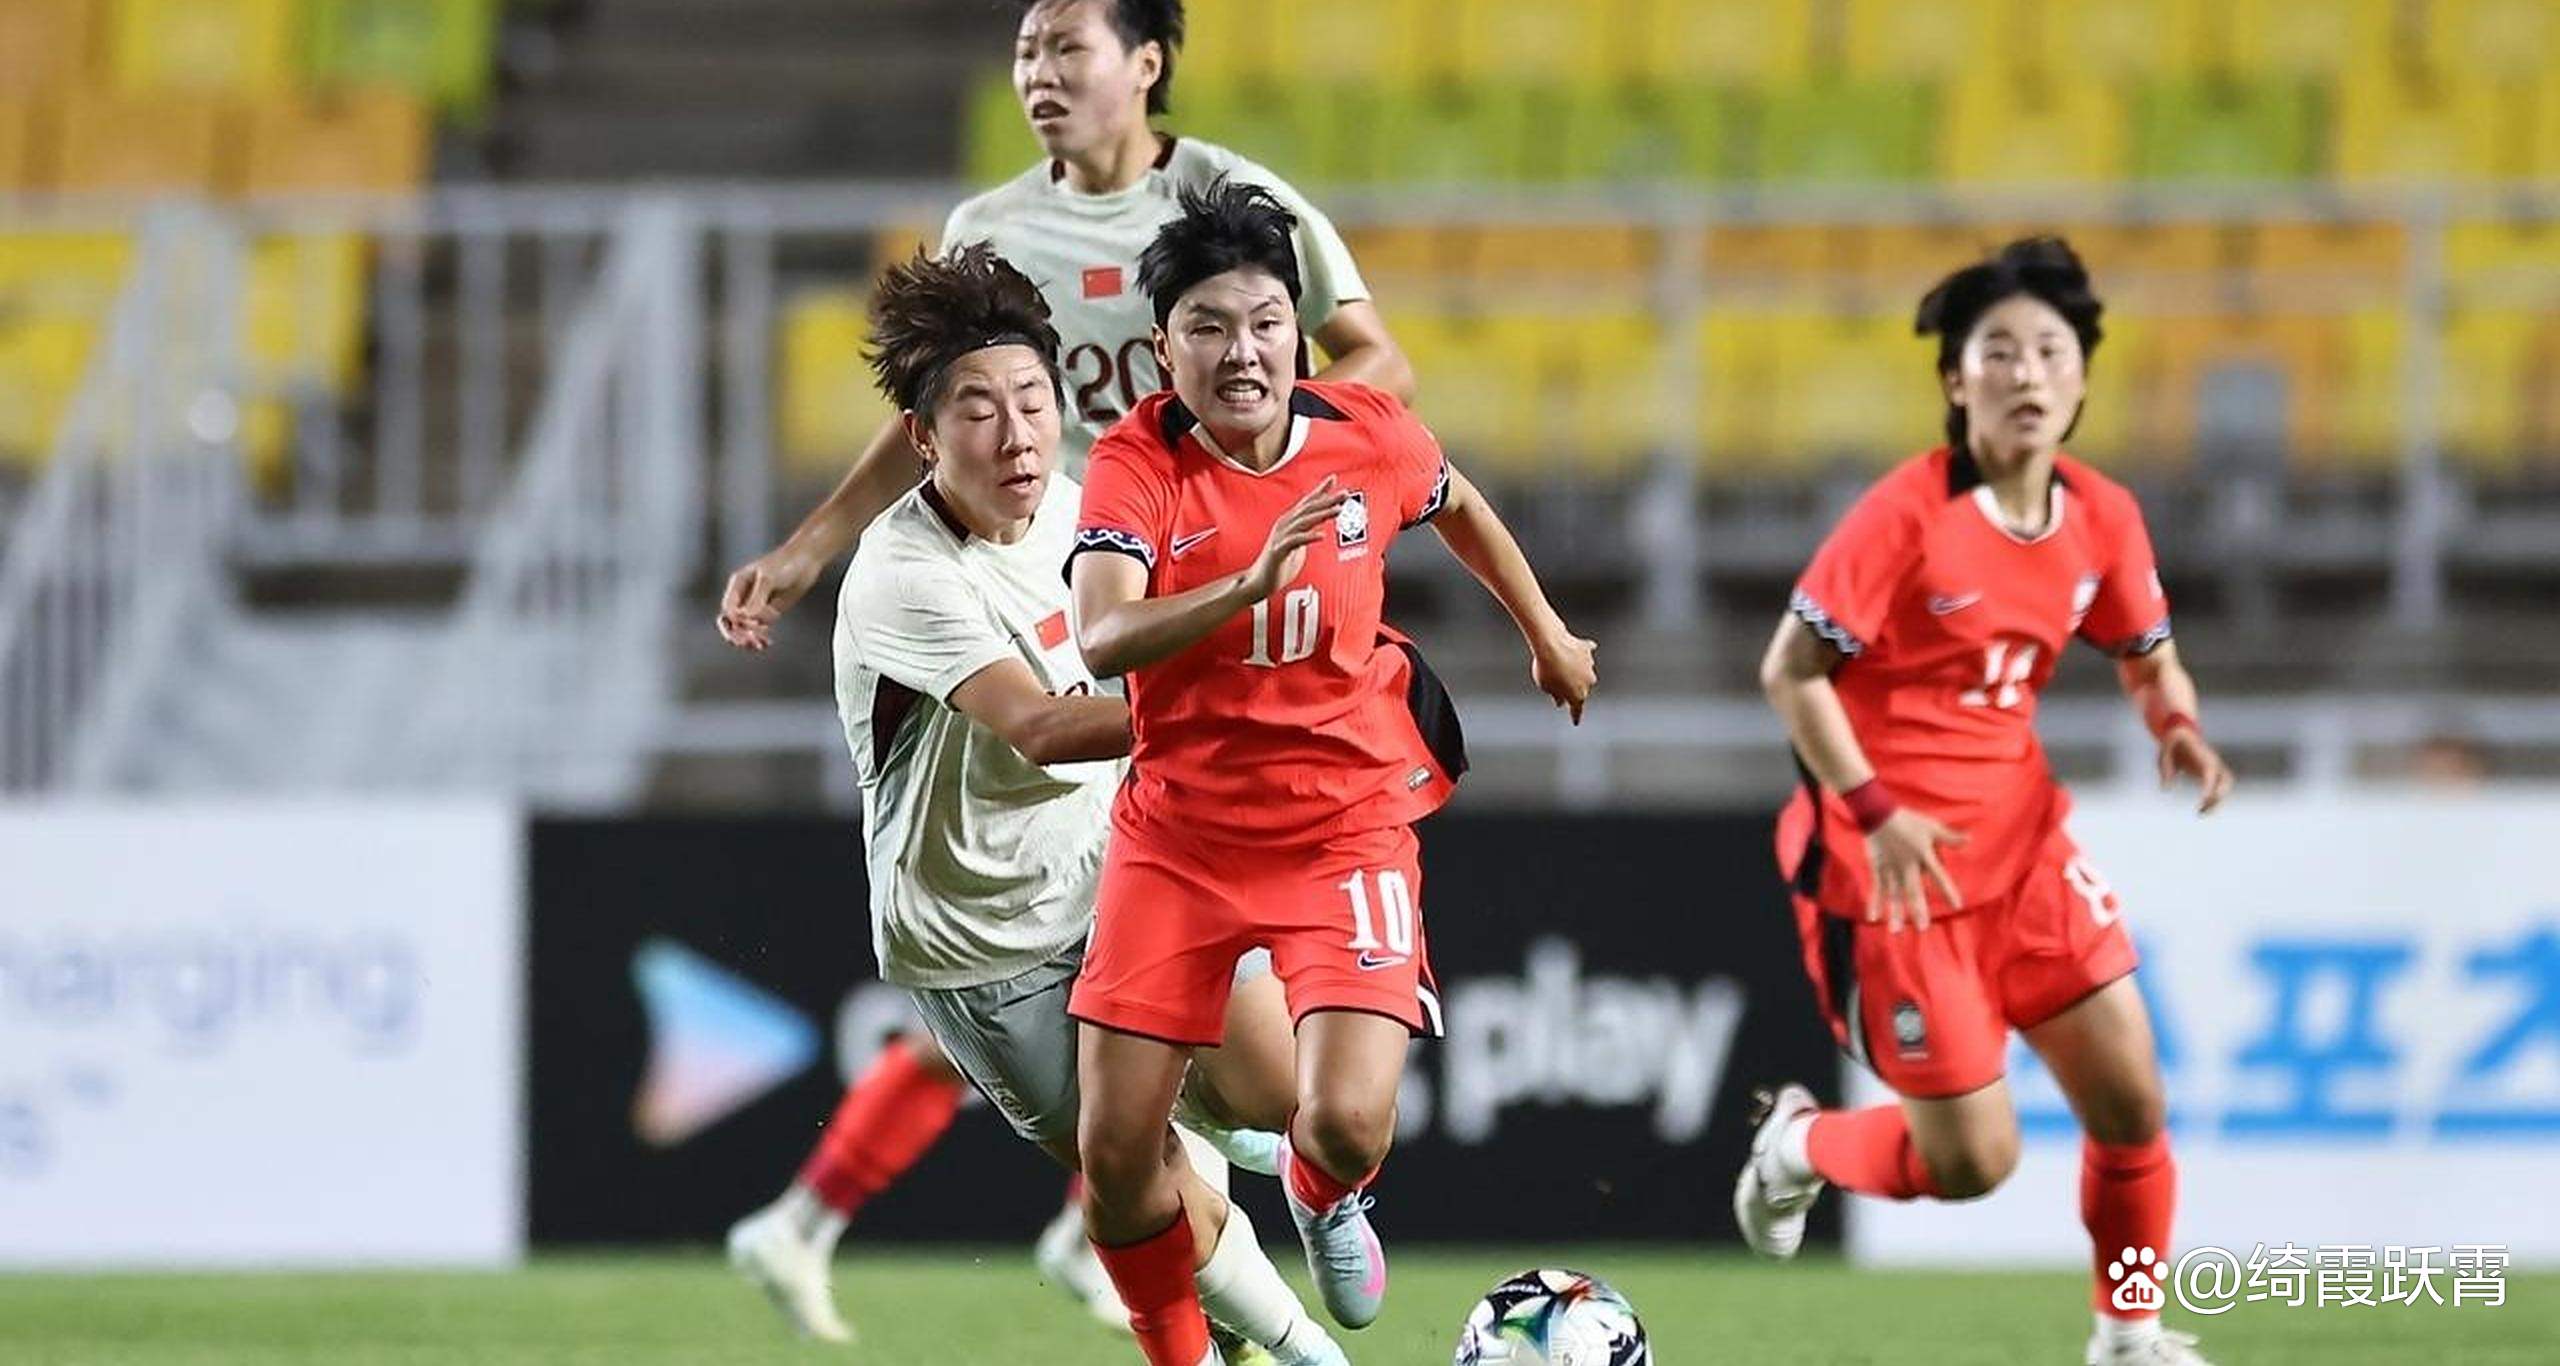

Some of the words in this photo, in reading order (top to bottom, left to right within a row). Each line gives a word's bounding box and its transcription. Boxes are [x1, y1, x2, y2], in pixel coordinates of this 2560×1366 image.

[1065, 339, 1173, 420] 20
[1242, 584, 1320, 668] 10
[1338, 868, 1414, 957] 10
[1445, 936, 1746, 1145] play
